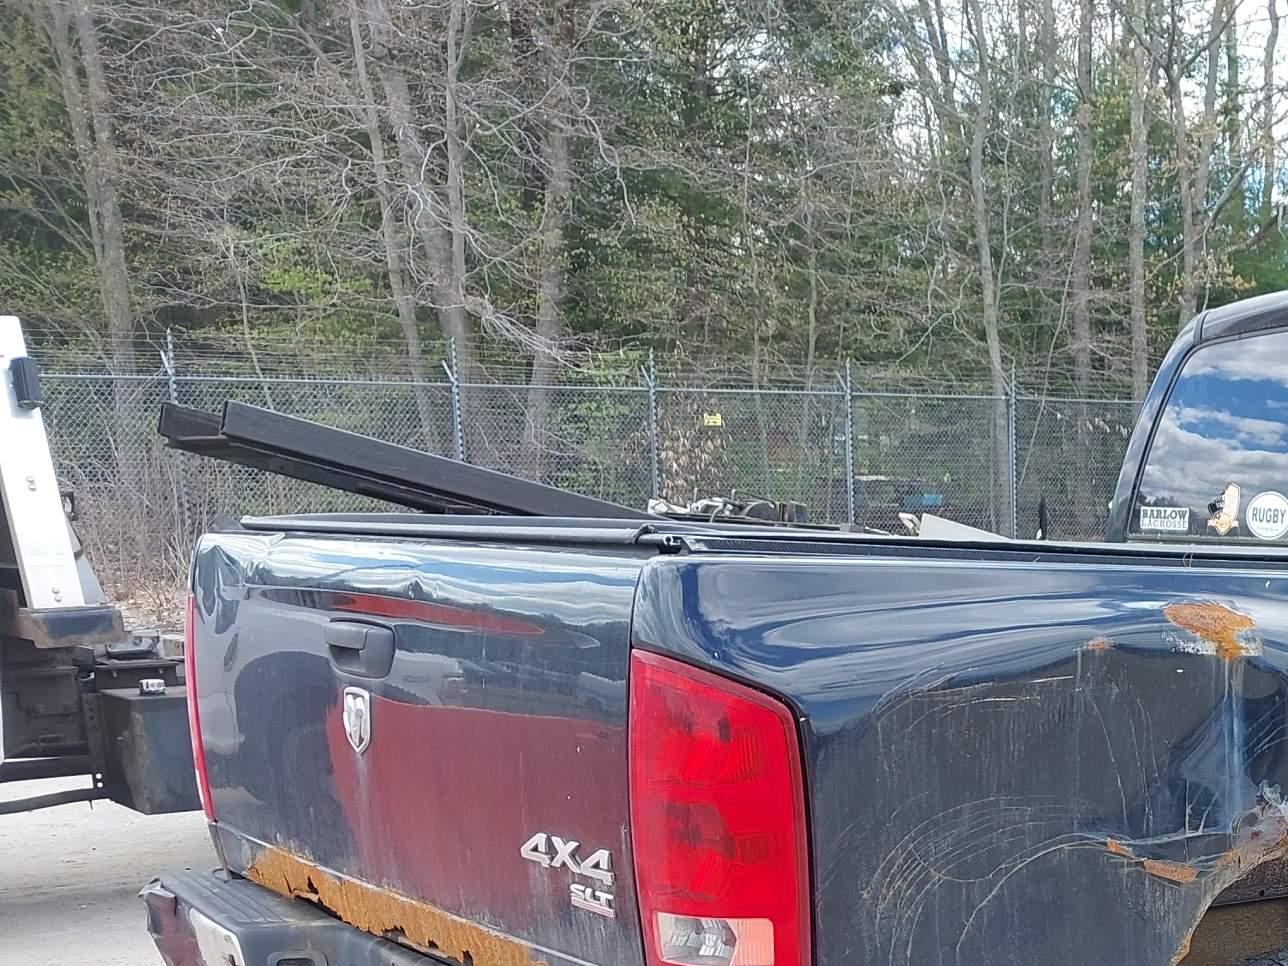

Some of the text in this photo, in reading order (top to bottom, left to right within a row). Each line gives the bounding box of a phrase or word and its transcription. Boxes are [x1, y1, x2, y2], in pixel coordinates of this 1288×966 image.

[1141, 508, 1188, 520] BARLOW
[1251, 506, 1287, 525] RUGBY
[1140, 519, 1188, 529] LACROSSE
[520, 832, 615, 886] 4X4
[569, 883, 615, 908] SLT
